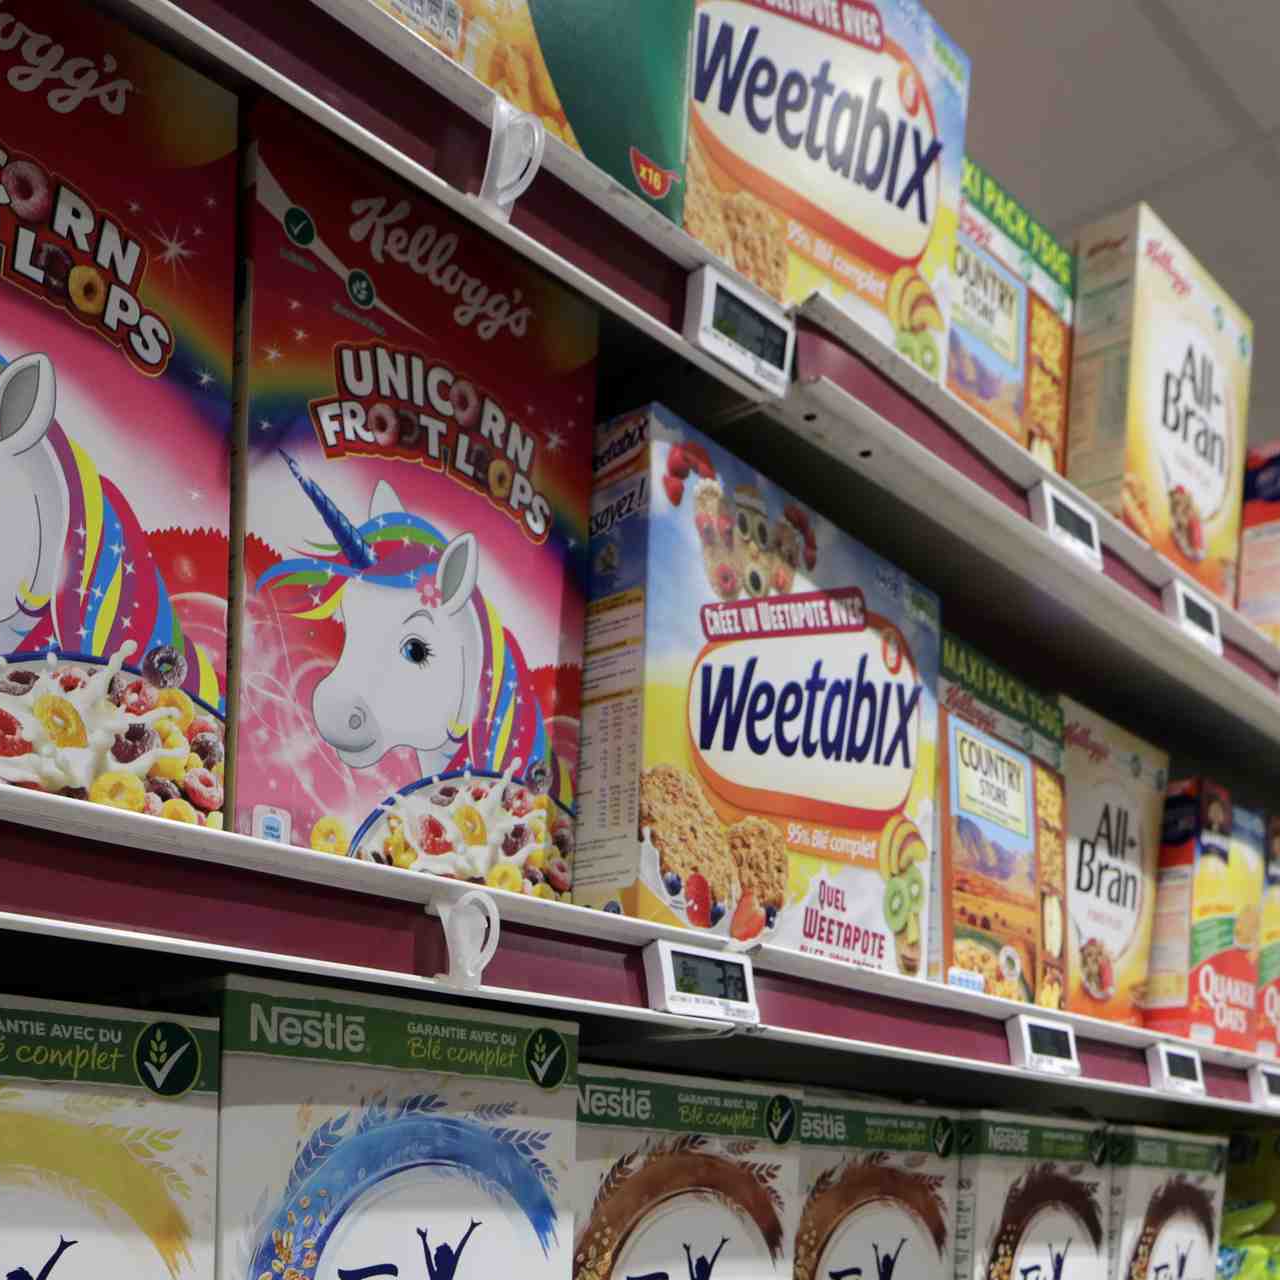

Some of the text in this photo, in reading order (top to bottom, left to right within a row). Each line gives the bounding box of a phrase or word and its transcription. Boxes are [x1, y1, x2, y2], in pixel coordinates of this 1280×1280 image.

[694, 13, 943, 224] Weetabix
[14, 225, 170, 365] LOOPS
[349, 197, 537, 341] Kellogg's
[341, 347, 533, 472] UNICORN
[1161, 371, 1225, 476] Bran
[455, 433, 550, 536] LOOPS
[700, 653, 922, 769] Weetabix
[960, 736, 1021, 792] COUNTRY
[818, 879, 846, 913] QUEL
[1076, 839, 1136, 911] Bran
[803, 906, 886, 960] WEETAPOTE
[50, 1023, 96, 1042] AVEC
[99, 1028, 122, 1044] DU
[250, 1004, 366, 1052] Nestlé
[407, 1020, 468, 1040] GARANTIE
[15, 1040, 125, 1081] complet
[577, 1084, 652, 1120] Nestlé
[800, 1113, 847, 1139] estlé
